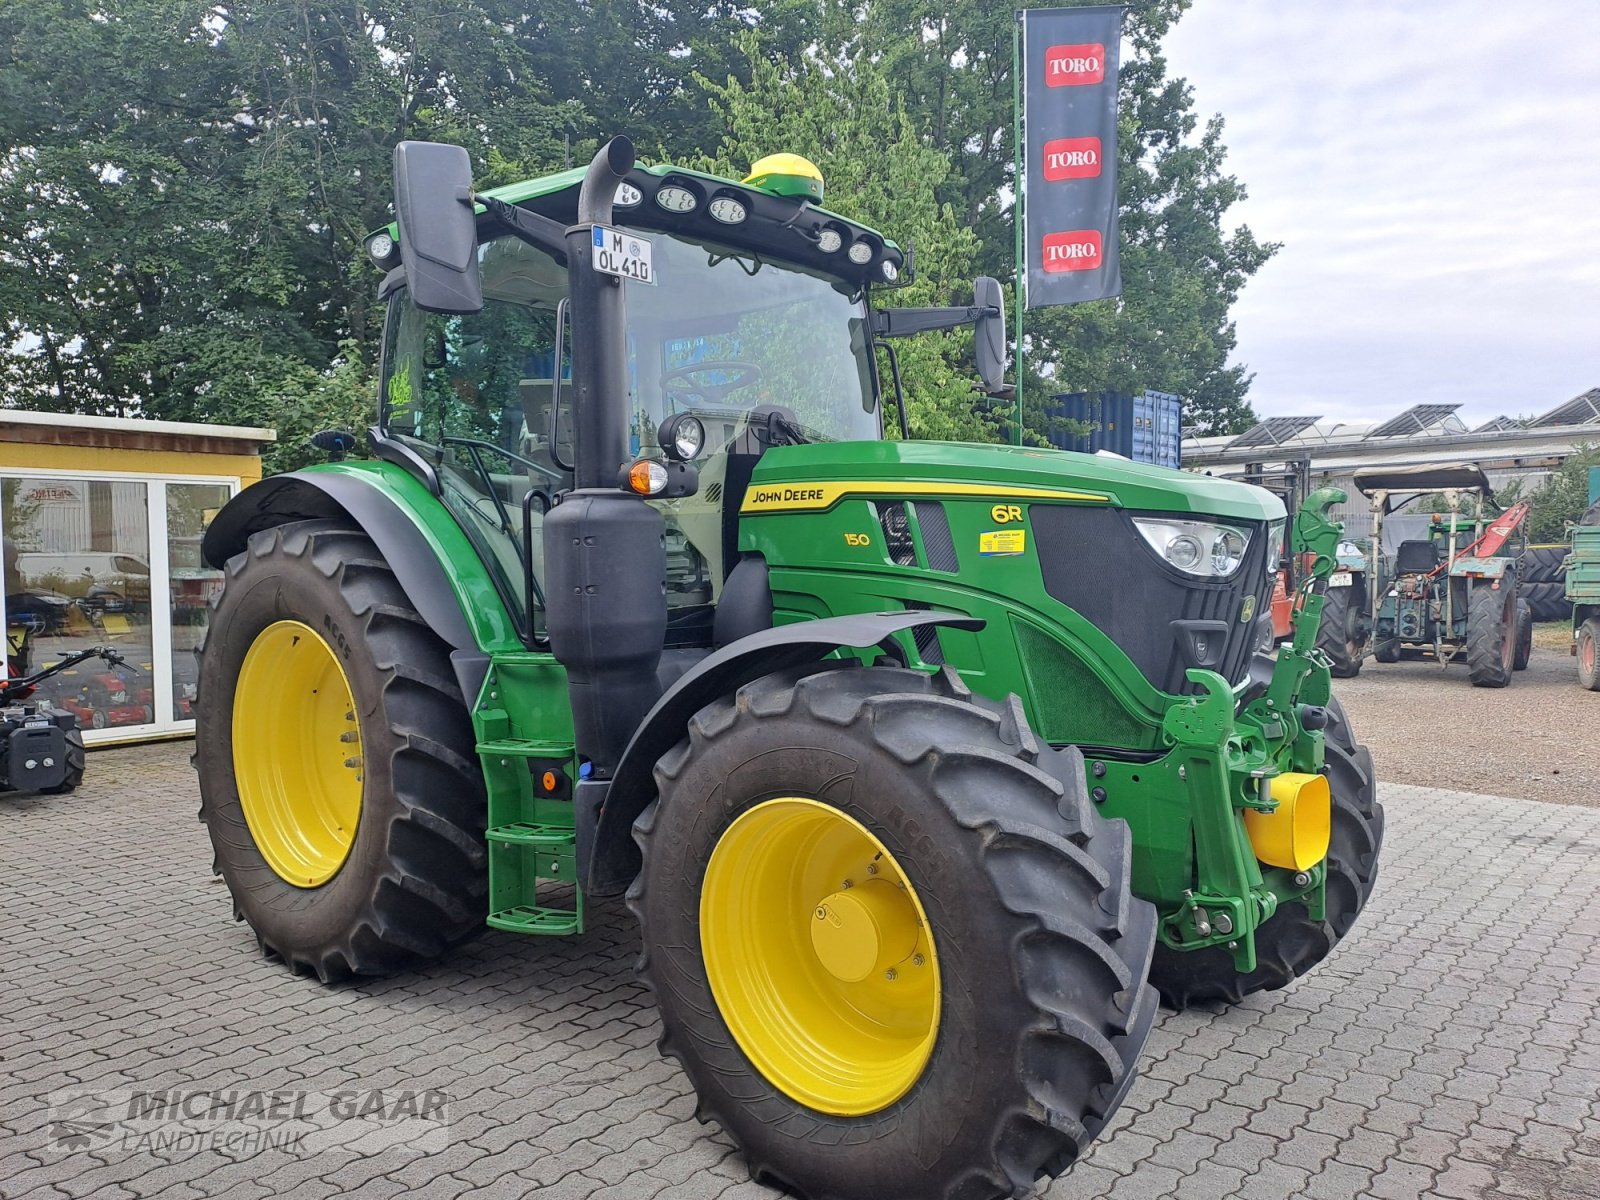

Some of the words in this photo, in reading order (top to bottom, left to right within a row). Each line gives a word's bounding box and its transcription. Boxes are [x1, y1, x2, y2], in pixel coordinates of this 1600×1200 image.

[613, 233, 622, 253] M
[599, 251, 619, 272] OL
[621, 257, 648, 280] 410
[752, 491, 782, 503] JOHN
[784, 489, 824, 501] DEERE
[991, 504, 1024, 524] 6R
[844, 533, 870, 546] 150
